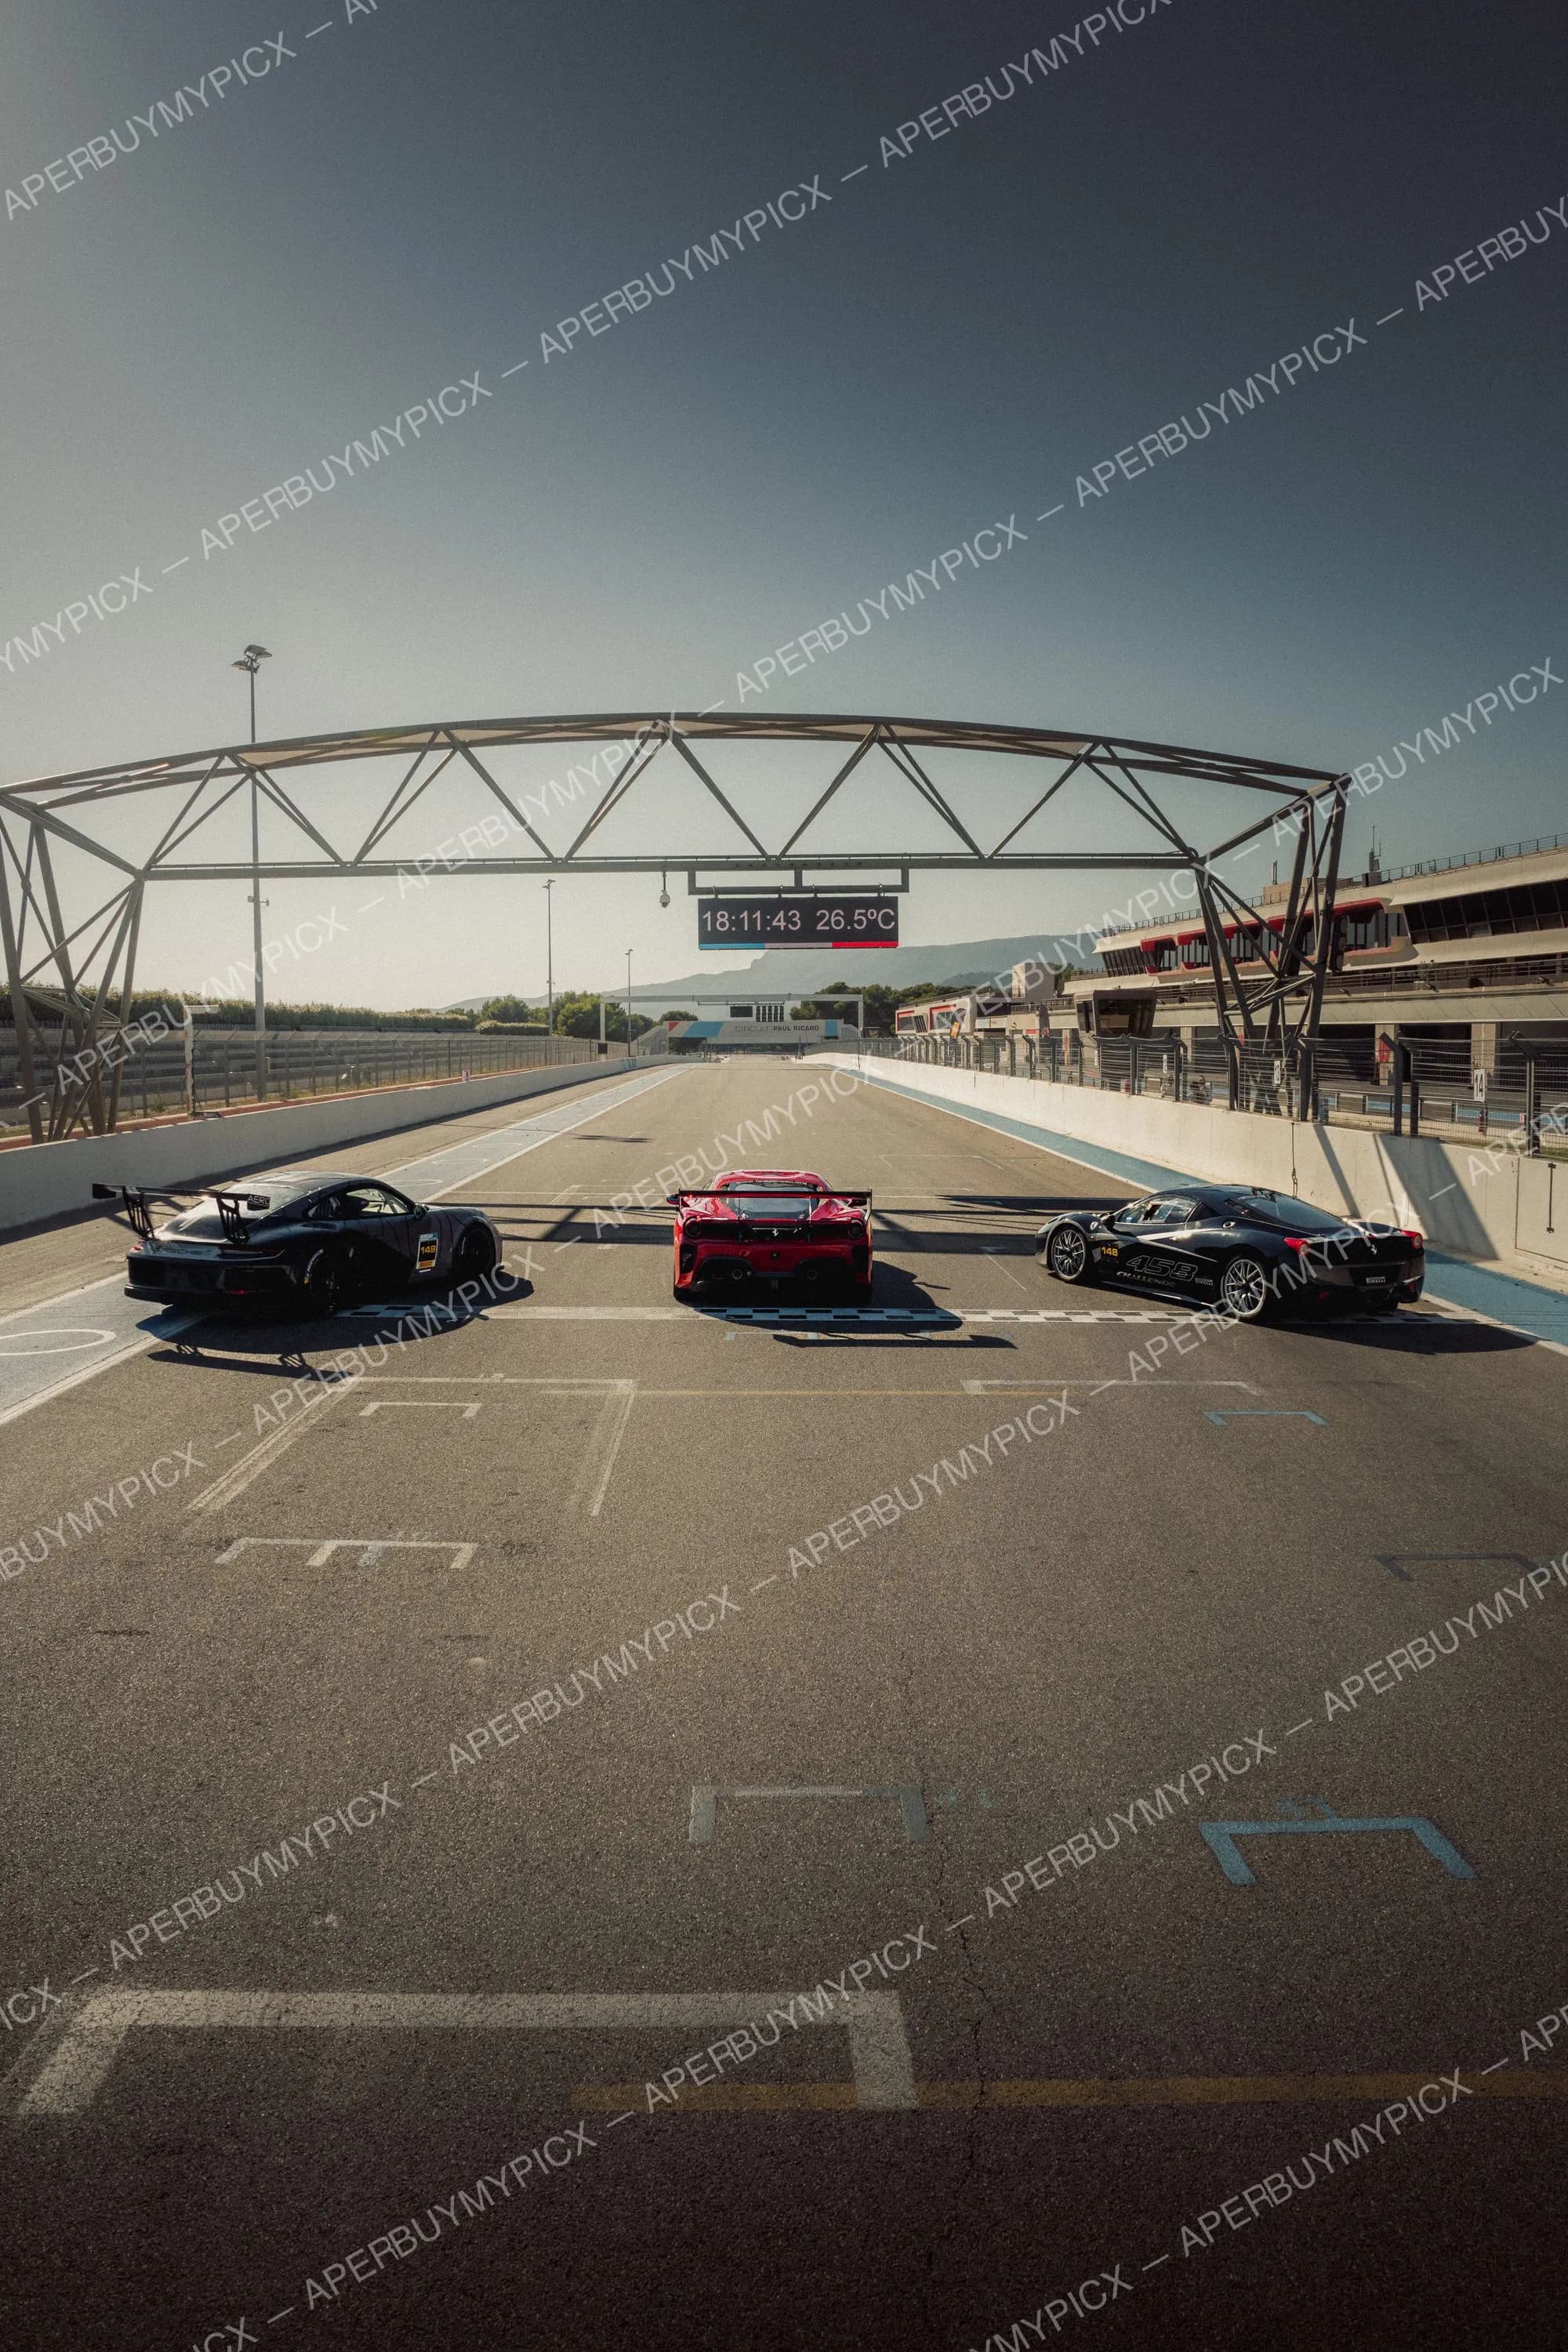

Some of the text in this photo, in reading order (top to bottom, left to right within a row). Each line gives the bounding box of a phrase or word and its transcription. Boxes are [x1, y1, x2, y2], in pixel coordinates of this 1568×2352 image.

[702, 909, 801, 931] 18:11:43
[1475, 1073, 1483, 1098] 14
[420, 1245, 437, 1254] 149
[1102, 1247, 1119, 1257] 148
[1126, 1254, 1198, 1282] 458
